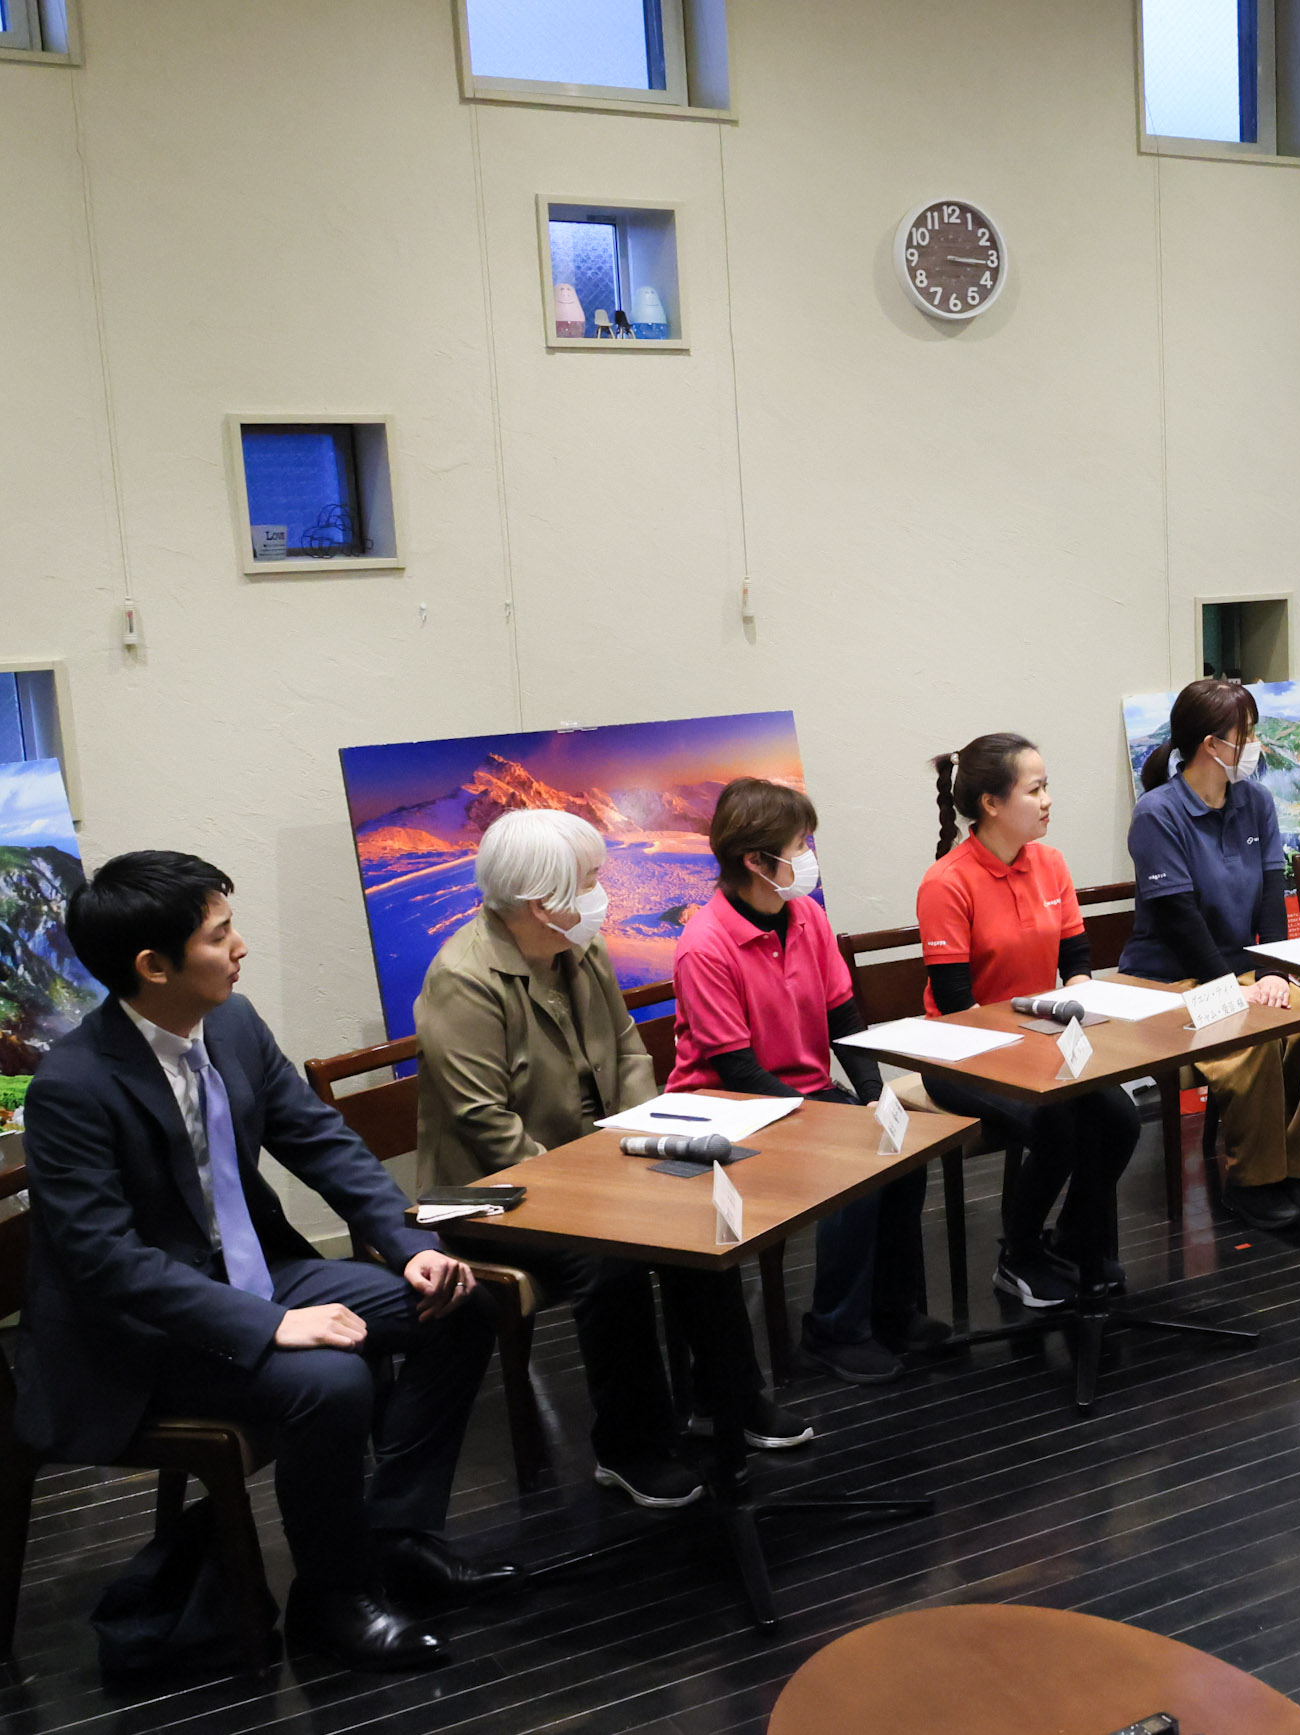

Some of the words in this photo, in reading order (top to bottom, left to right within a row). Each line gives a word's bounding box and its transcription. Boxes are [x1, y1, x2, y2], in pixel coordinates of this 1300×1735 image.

[926, 211, 939, 230] 11
[943, 205, 961, 223] 12
[966, 212, 973, 230] 1
[911, 227, 930, 246] 10
[977, 228, 991, 246] 2
[906, 248, 919, 266] 9
[987, 250, 999, 268] 3
[915, 269, 928, 287] 8
[979, 271, 993, 288] 4
[929, 287, 943, 305] 7
[949, 293, 962, 311] 6
[967, 287, 980, 305] 5
